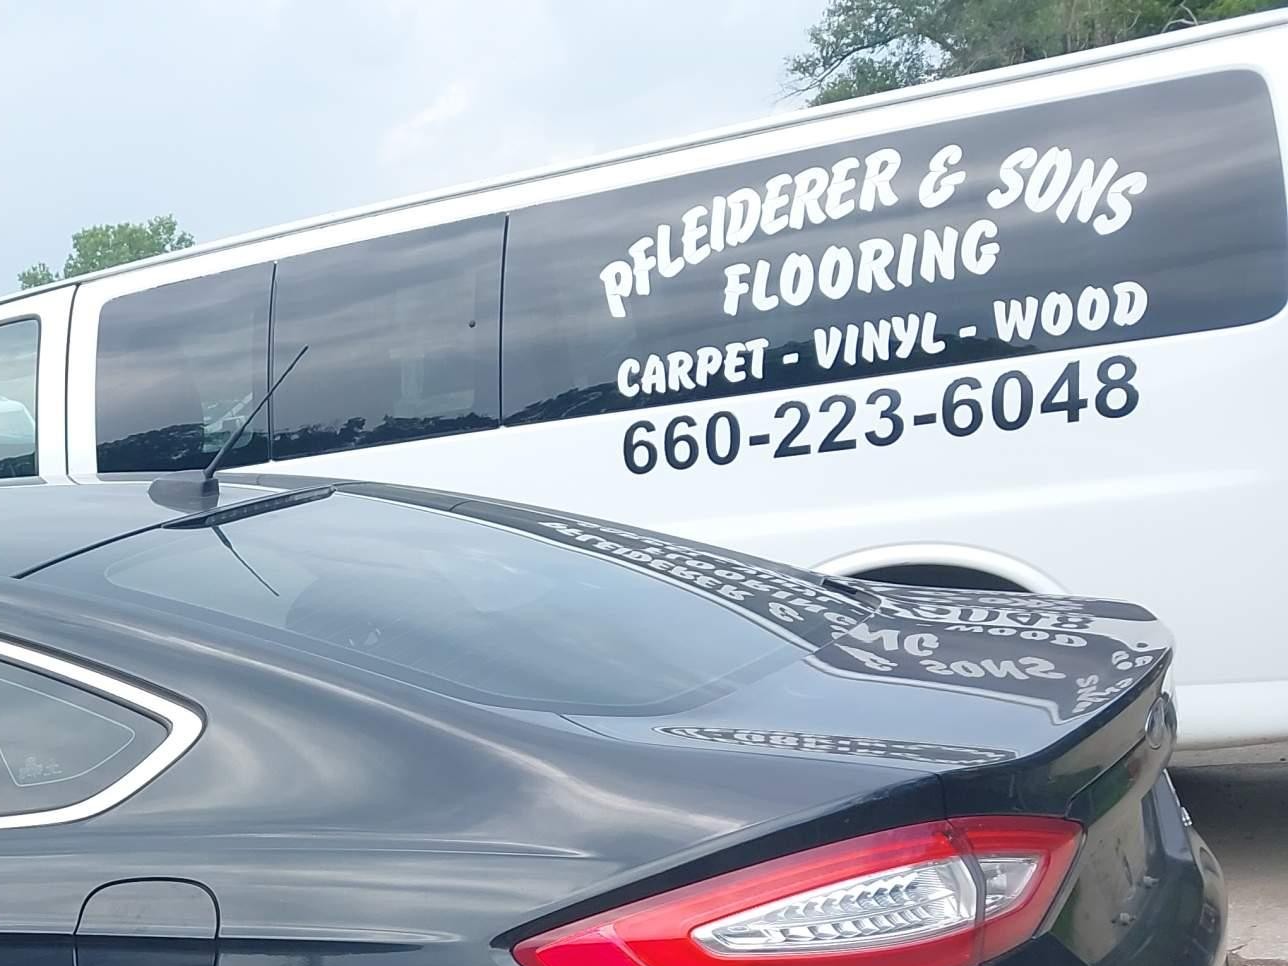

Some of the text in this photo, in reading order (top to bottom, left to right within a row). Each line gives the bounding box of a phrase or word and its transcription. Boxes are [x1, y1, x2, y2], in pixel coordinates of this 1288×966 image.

[600, 144, 1149, 317] PFLEIDERER & SONS
[723, 219, 1001, 316] FLOORING
[617, 281, 1149, 398] CARPET - VINYL - WOOD
[622, 354, 1141, 476] 660-223-6048
